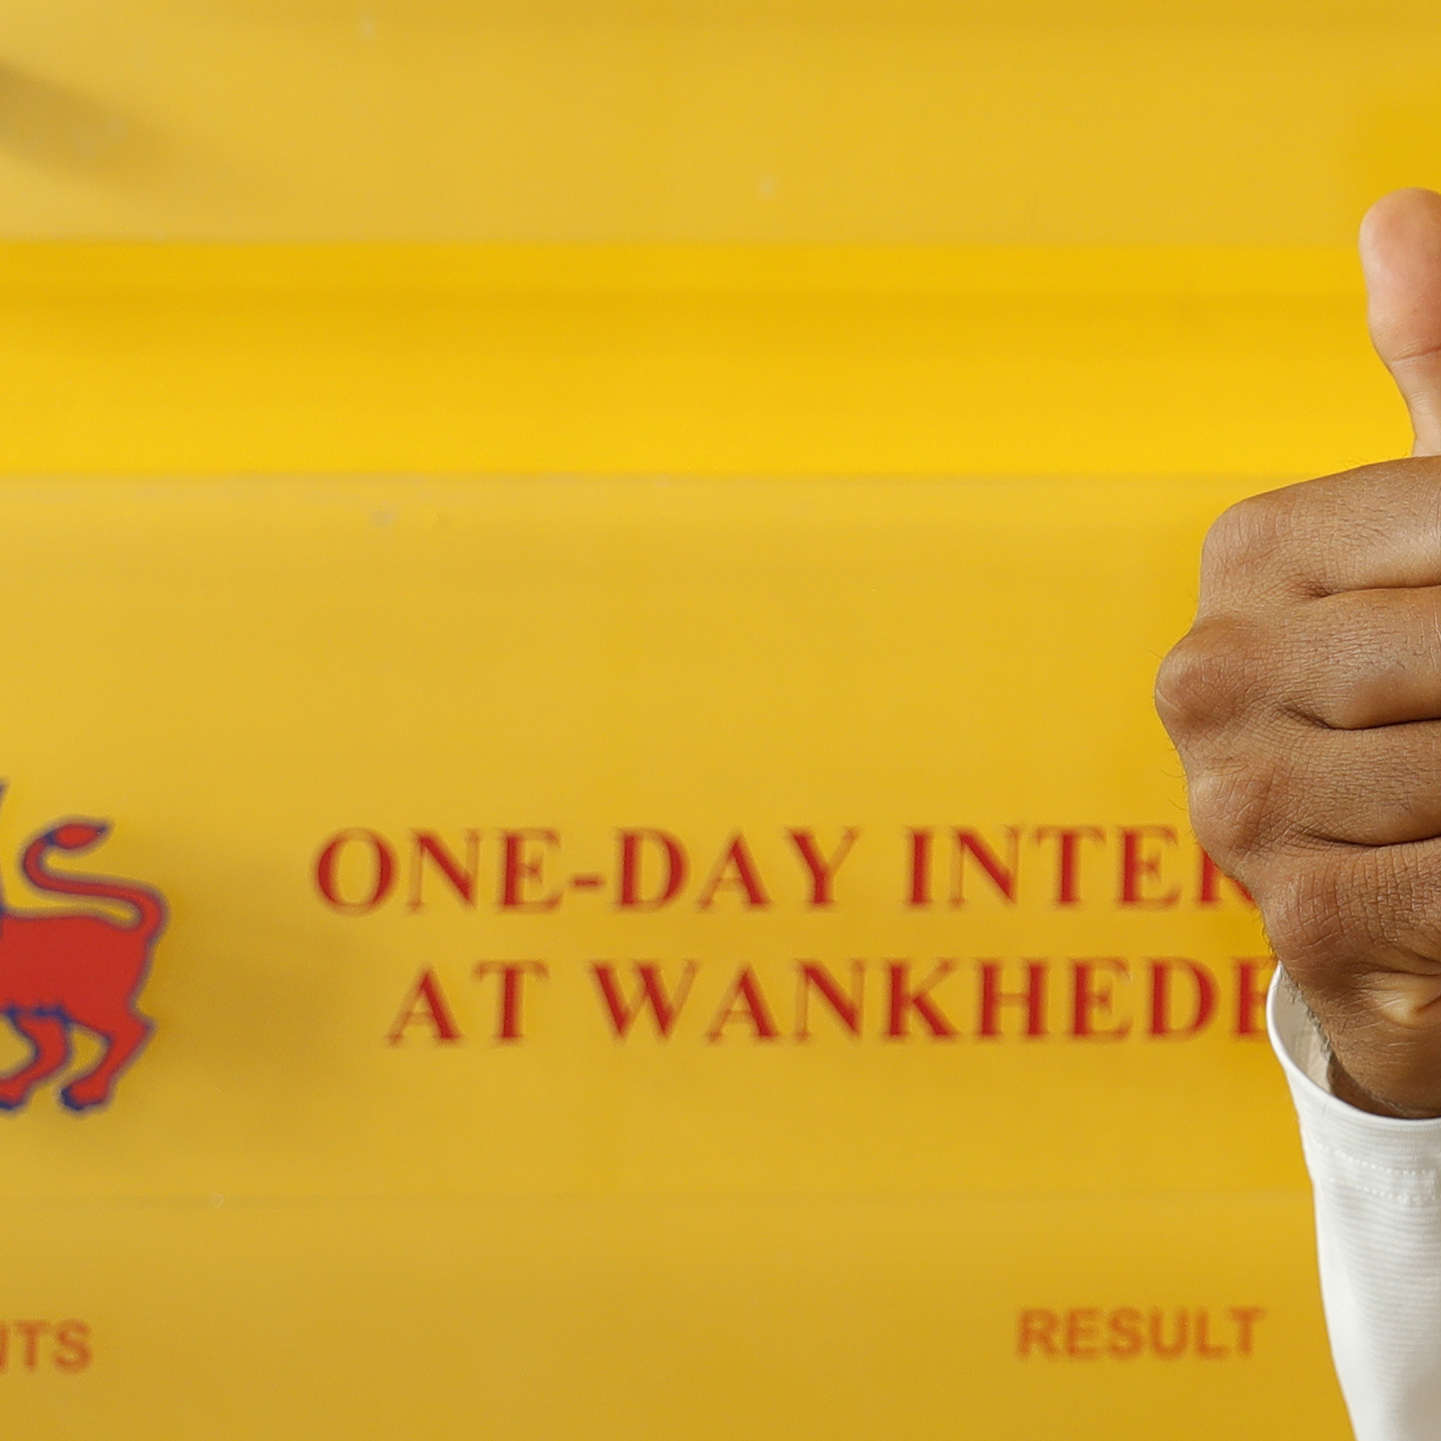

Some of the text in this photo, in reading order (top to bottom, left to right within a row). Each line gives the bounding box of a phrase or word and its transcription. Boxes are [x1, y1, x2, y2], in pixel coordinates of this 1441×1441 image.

[312, 825, 860, 915] ONE-DAY
[388, 958, 550, 1046] AT
[1017, 1307, 1267, 1360] RESULT
